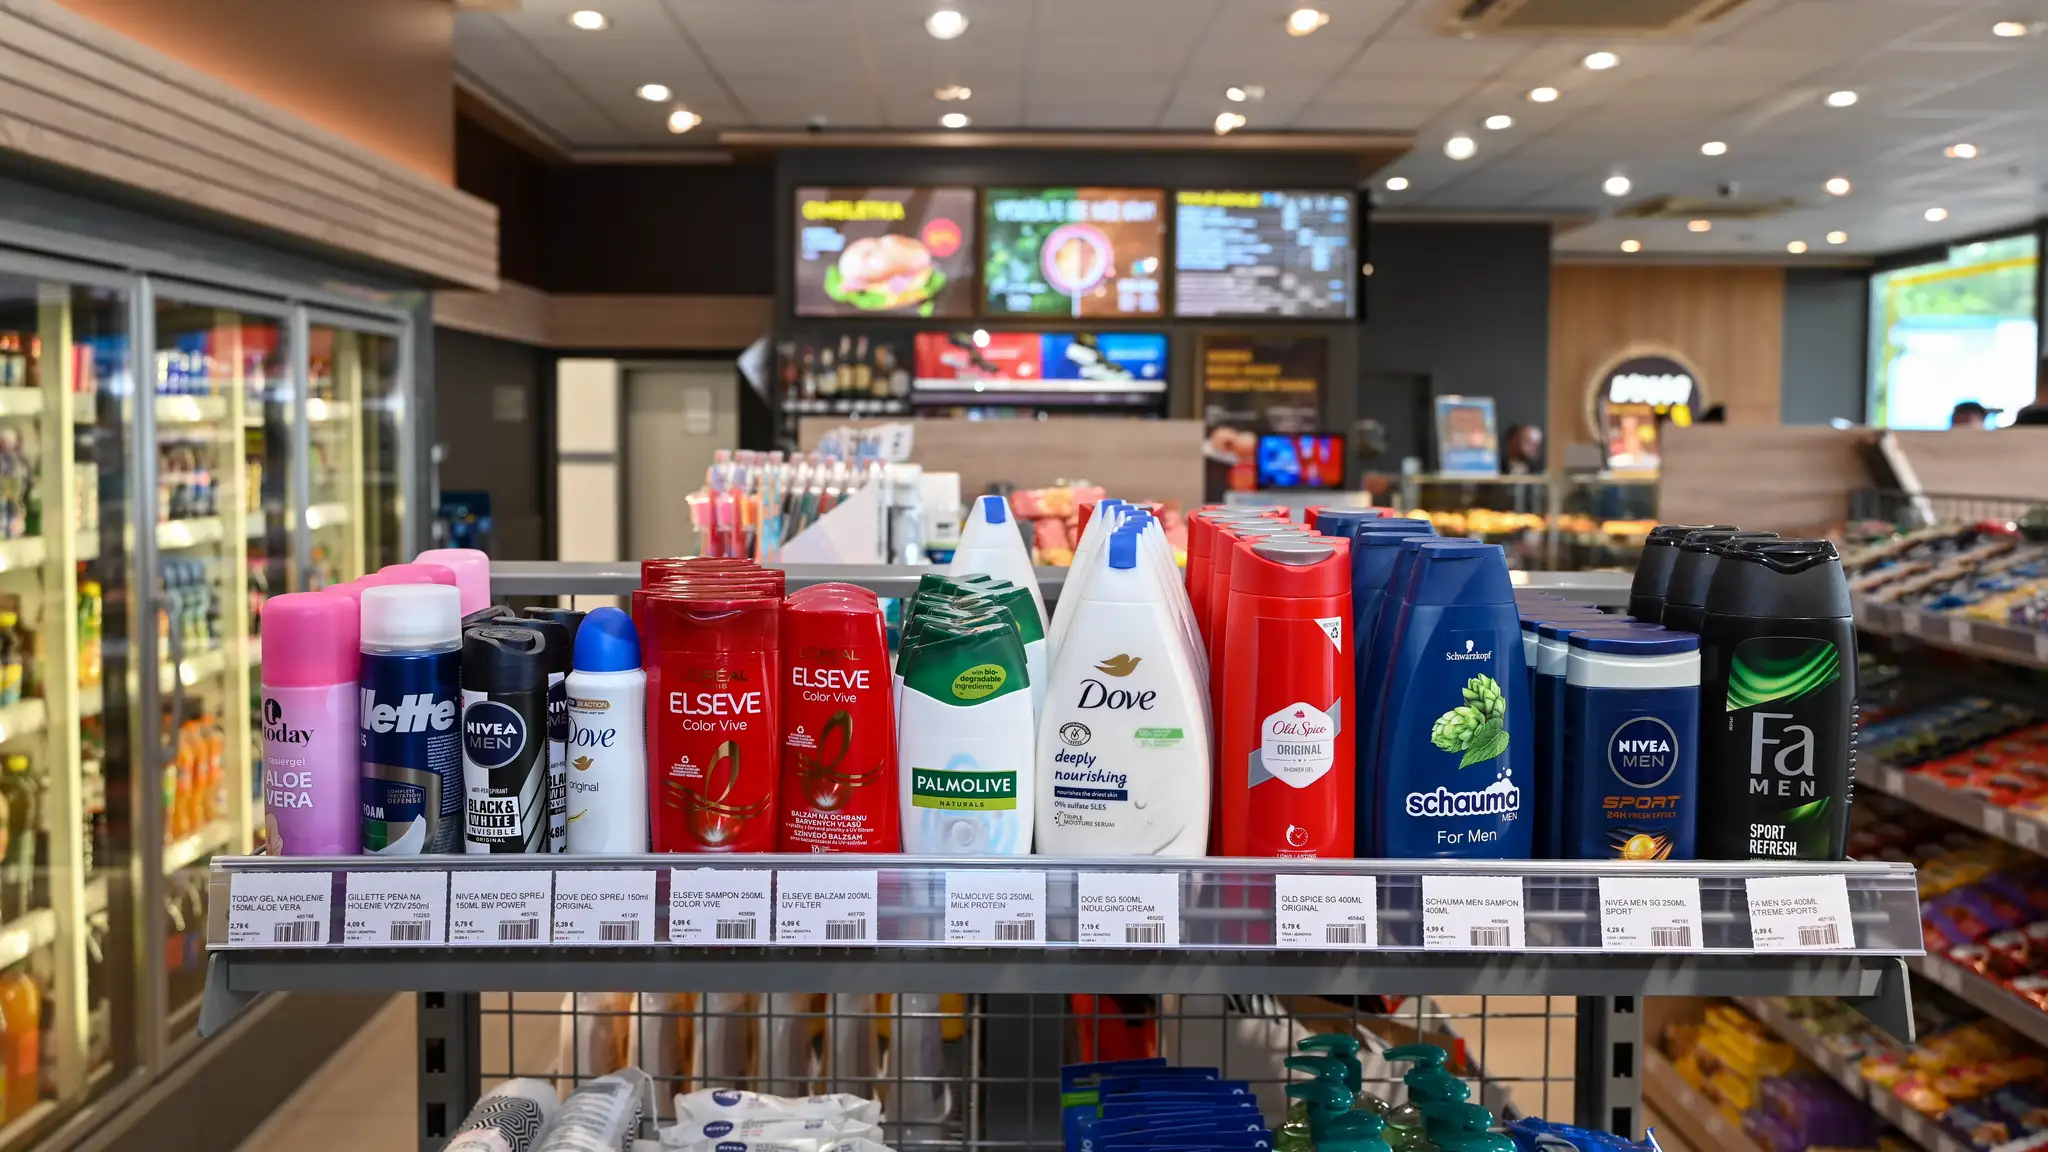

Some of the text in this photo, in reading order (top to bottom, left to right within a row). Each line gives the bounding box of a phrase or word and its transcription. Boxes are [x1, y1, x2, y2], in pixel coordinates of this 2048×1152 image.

[1446, 651, 1492, 661] Schwarzkopf
[793, 667, 869, 689] ELSEVE
[803, 691, 856, 702] Color Vive
[1078, 679, 1156, 710] Dove
[670, 692, 760, 715] ELSEVE
[467, 721, 517, 735] NIVEA
[683, 720, 747, 731] Color Vive
[1273, 721, 1325, 737] Old Spice
[264, 723, 314, 747] today
[470, 737, 511, 749] MEN
[1619, 740, 1670, 752] NIVEA
[1751, 712, 1814, 776] Fa
[1277, 745, 1321, 755] ORIGINAL
[269, 757, 306, 767] rasiergel
[1055, 748, 1096, 768] deeply
[1623, 755, 1664, 767] MEN
[266, 770, 312, 788] ALOE
[917, 776, 1010, 792] PALMOLIVE
[1055, 769, 1127, 788] nourishing
[472, 787, 508, 795] ANTI-PERSPIRANT
[570, 781, 599, 793] original
[1750, 778, 1814, 796] MEN
[266, 789, 313, 808] VERA
[1407, 787, 1519, 816] schauma
[1602, 795, 1682, 808] SPORT
[792, 810, 817, 818] BALZÁM
[1502, 812, 1518, 822] MEN
[470, 815, 510, 827] WHITE
[796, 818, 836, 827] BARVENÝCH
[468, 827, 515, 835] INVISIBLE
[1437, 829, 1497, 844] For Men
[1750, 824, 1785, 839] SPORT
[1750, 839, 1797, 855] REFRESH
[1786, 907, 1818, 915] SPORTS
